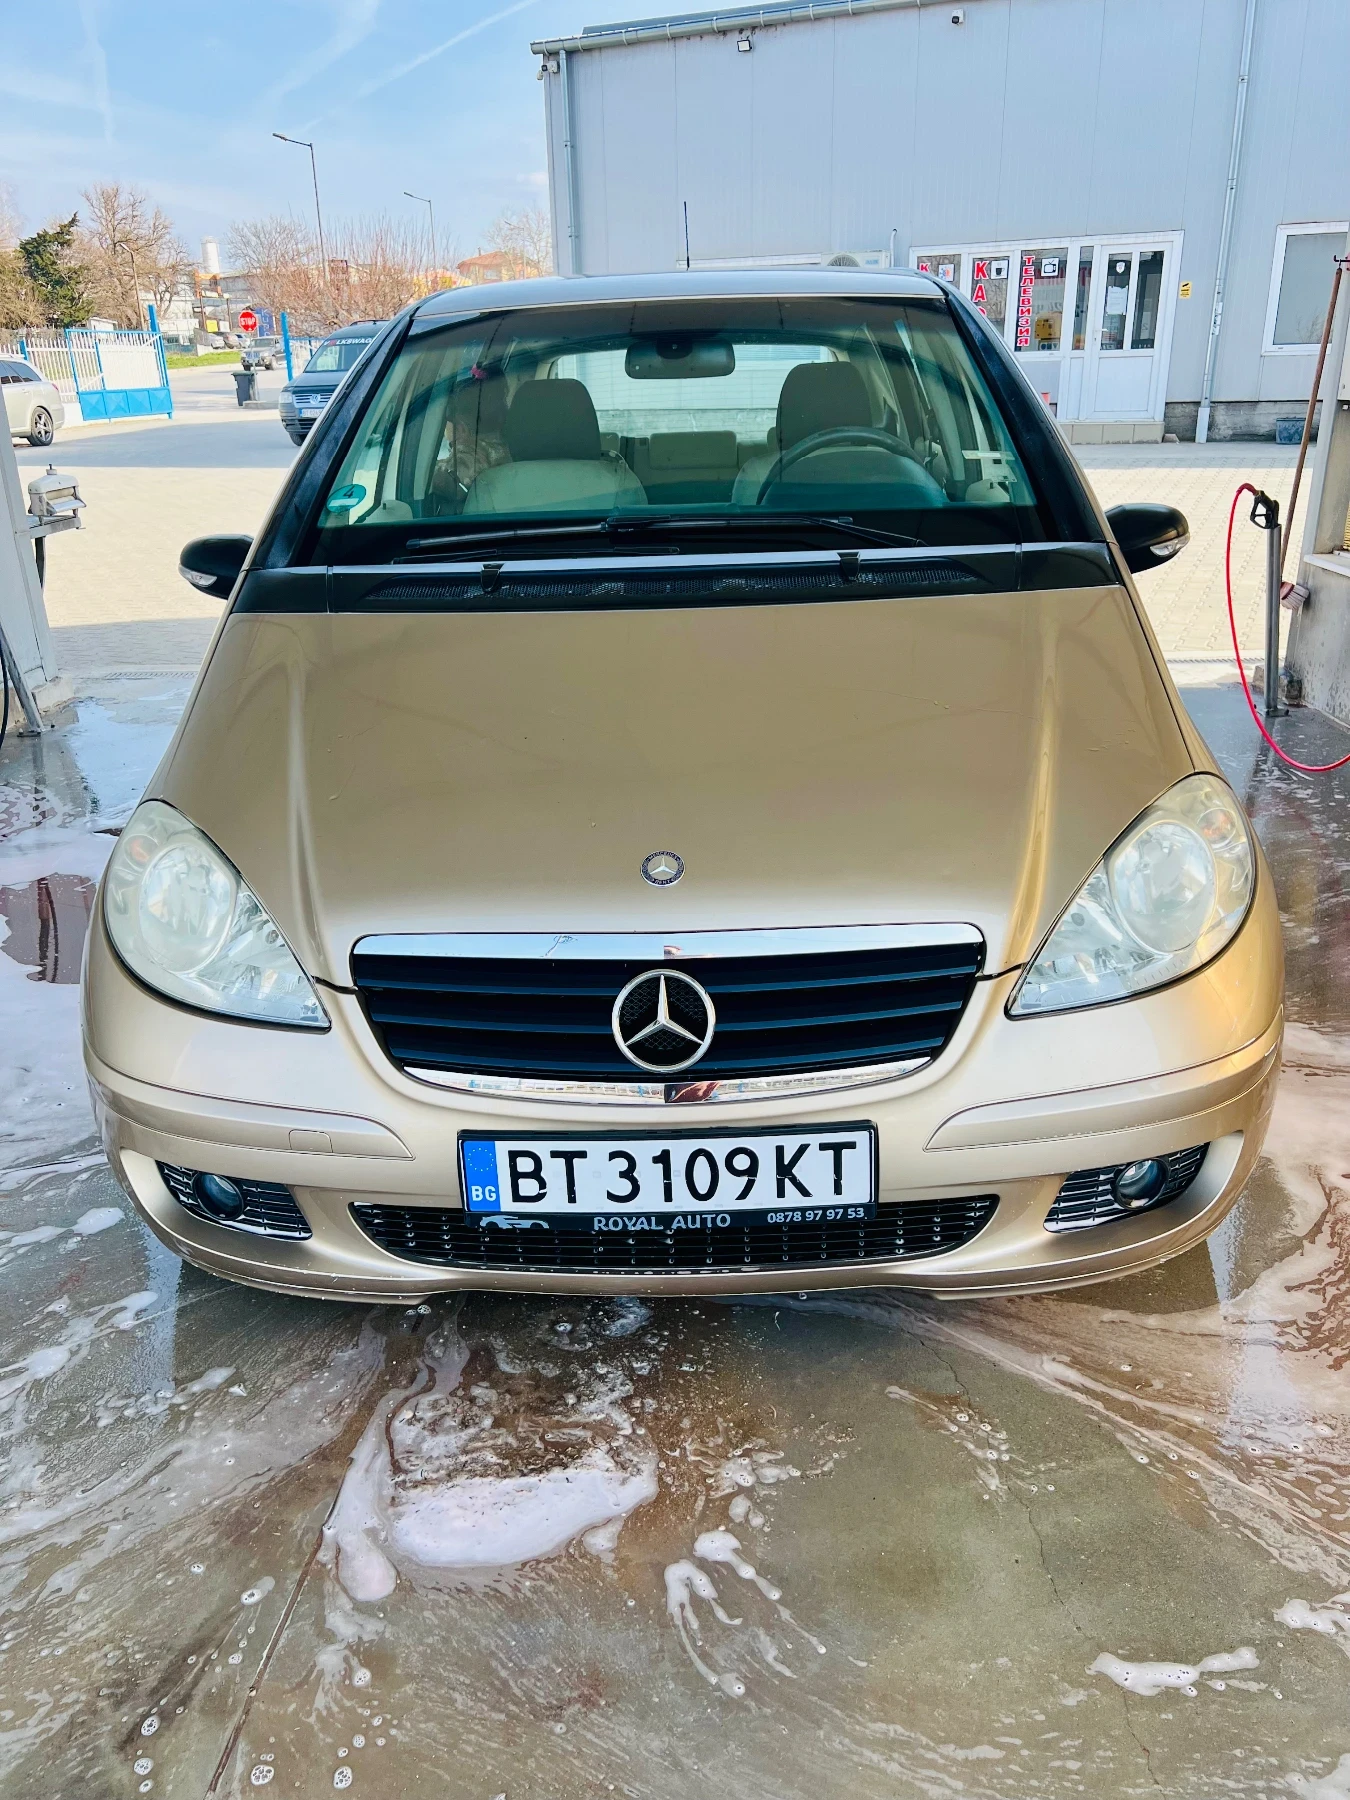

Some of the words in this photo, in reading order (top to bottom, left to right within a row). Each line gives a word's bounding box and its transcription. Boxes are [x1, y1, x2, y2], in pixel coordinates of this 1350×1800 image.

[1017, 256, 1035, 347] ТЕЛЕВИЗИЯ
[240, 317, 256, 325] STOP
[324, 338, 373, 346] VLKSWAG
[343, 485, 355, 499] 4
[508, 1150, 588, 1204] BT
[606, 1146, 760, 1204] 3109
[775, 1141, 858, 1199] KT
[471, 1186, 497, 1202] BG
[593, 1216, 664, 1231] ROYAL
[670, 1213, 731, 1230] AUTO
[767, 1211, 802, 1223] 0878
[805, 1209, 823, 1221] 97
[826, 1208, 844, 1220] 97
[847, 1207, 865, 1219] 53
